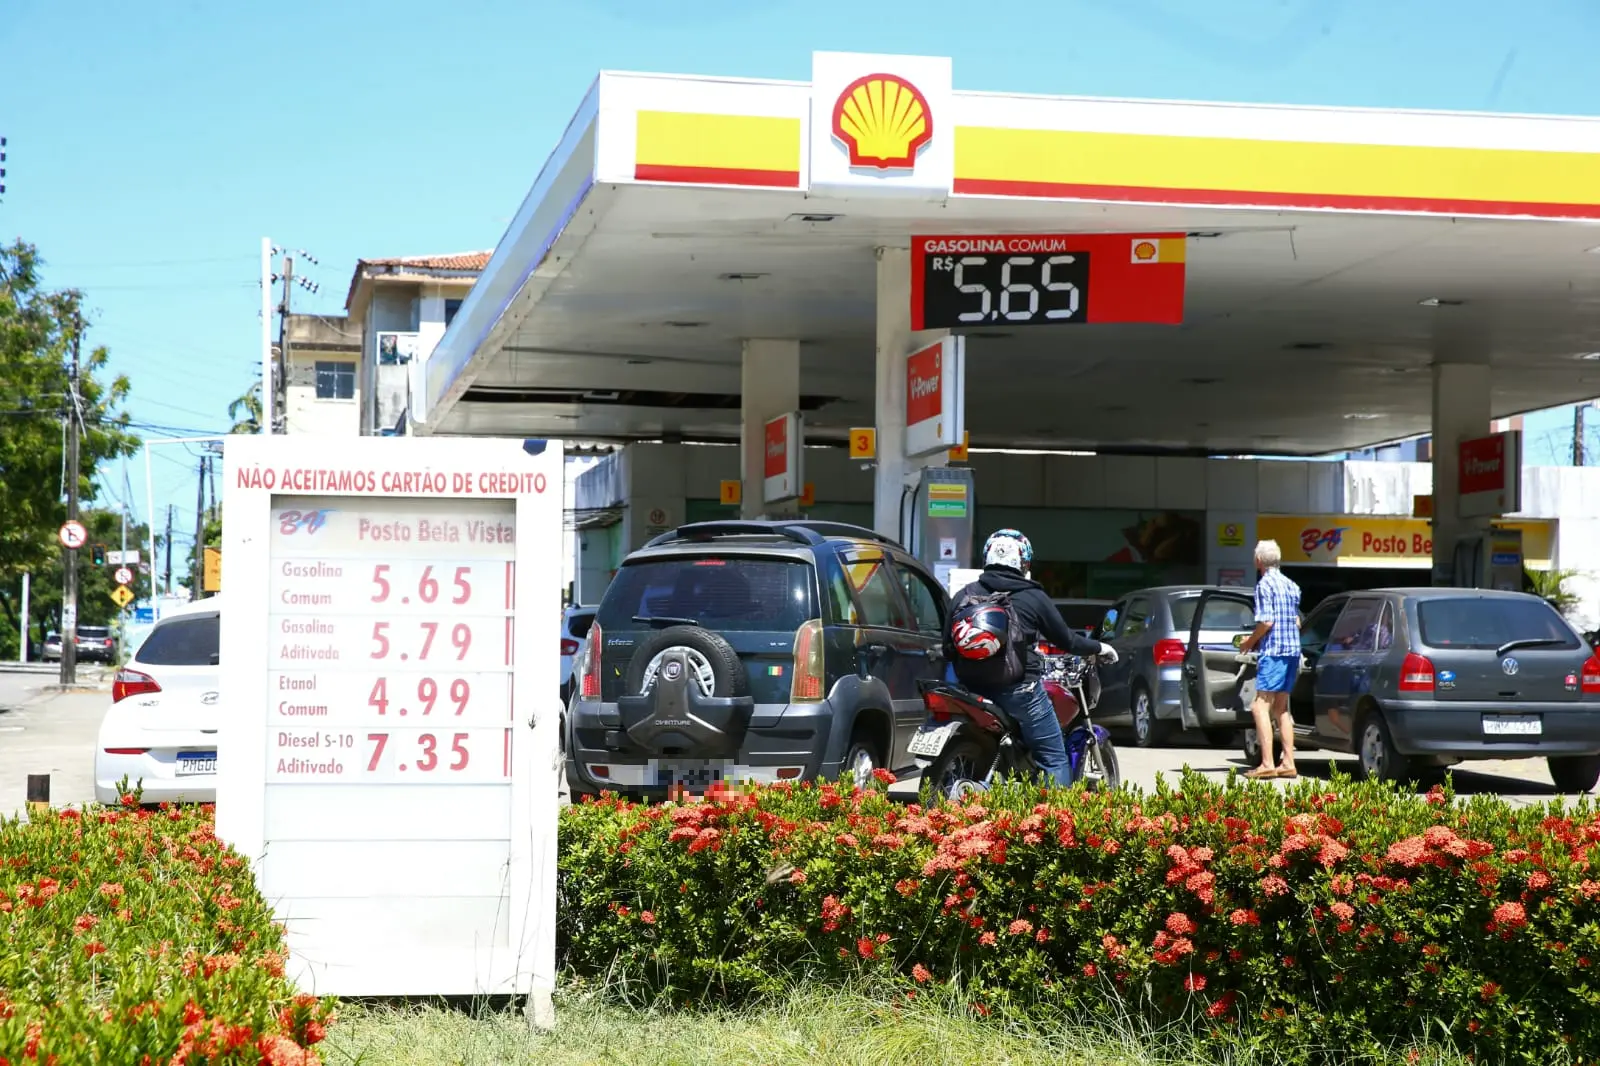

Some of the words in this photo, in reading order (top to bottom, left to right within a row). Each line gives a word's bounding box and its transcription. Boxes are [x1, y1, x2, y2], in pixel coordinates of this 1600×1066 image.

[924, 239, 1005, 253] GASOLINA
[1008, 239, 1066, 252] COMUM
[932, 257, 954, 272] R$
[953, 255, 1080, 322] 5,65
[910, 376, 940, 400] V-Power
[857, 435, 869, 451] 3
[237, 462, 276, 490] NÃO
[280, 468, 376, 492] ACEITAMOS
[452, 472, 473, 494] DE
[358, 517, 411, 542] Posto
[417, 520, 460, 543] Bela
[467, 520, 515, 544] Vista
[1362, 532, 1406, 554] Posto
[1412, 534, 1432, 554] Be
[281, 562, 343, 579] Gasolina
[371, 564, 472, 606] 5.65
[281, 590, 333, 606] Comum
[281, 619, 334, 635] Gasolina
[370, 621, 473, 662] 5.79
[278, 675, 317, 691] Etanol
[367, 677, 471, 717] 4.99
[278, 701, 328, 717] Comum
[278, 732, 320, 749] Diesel
[324, 734, 354, 749] S-10
[366, 732, 470, 772] 7.35
[276, 758, 344, 775] Aditivado
